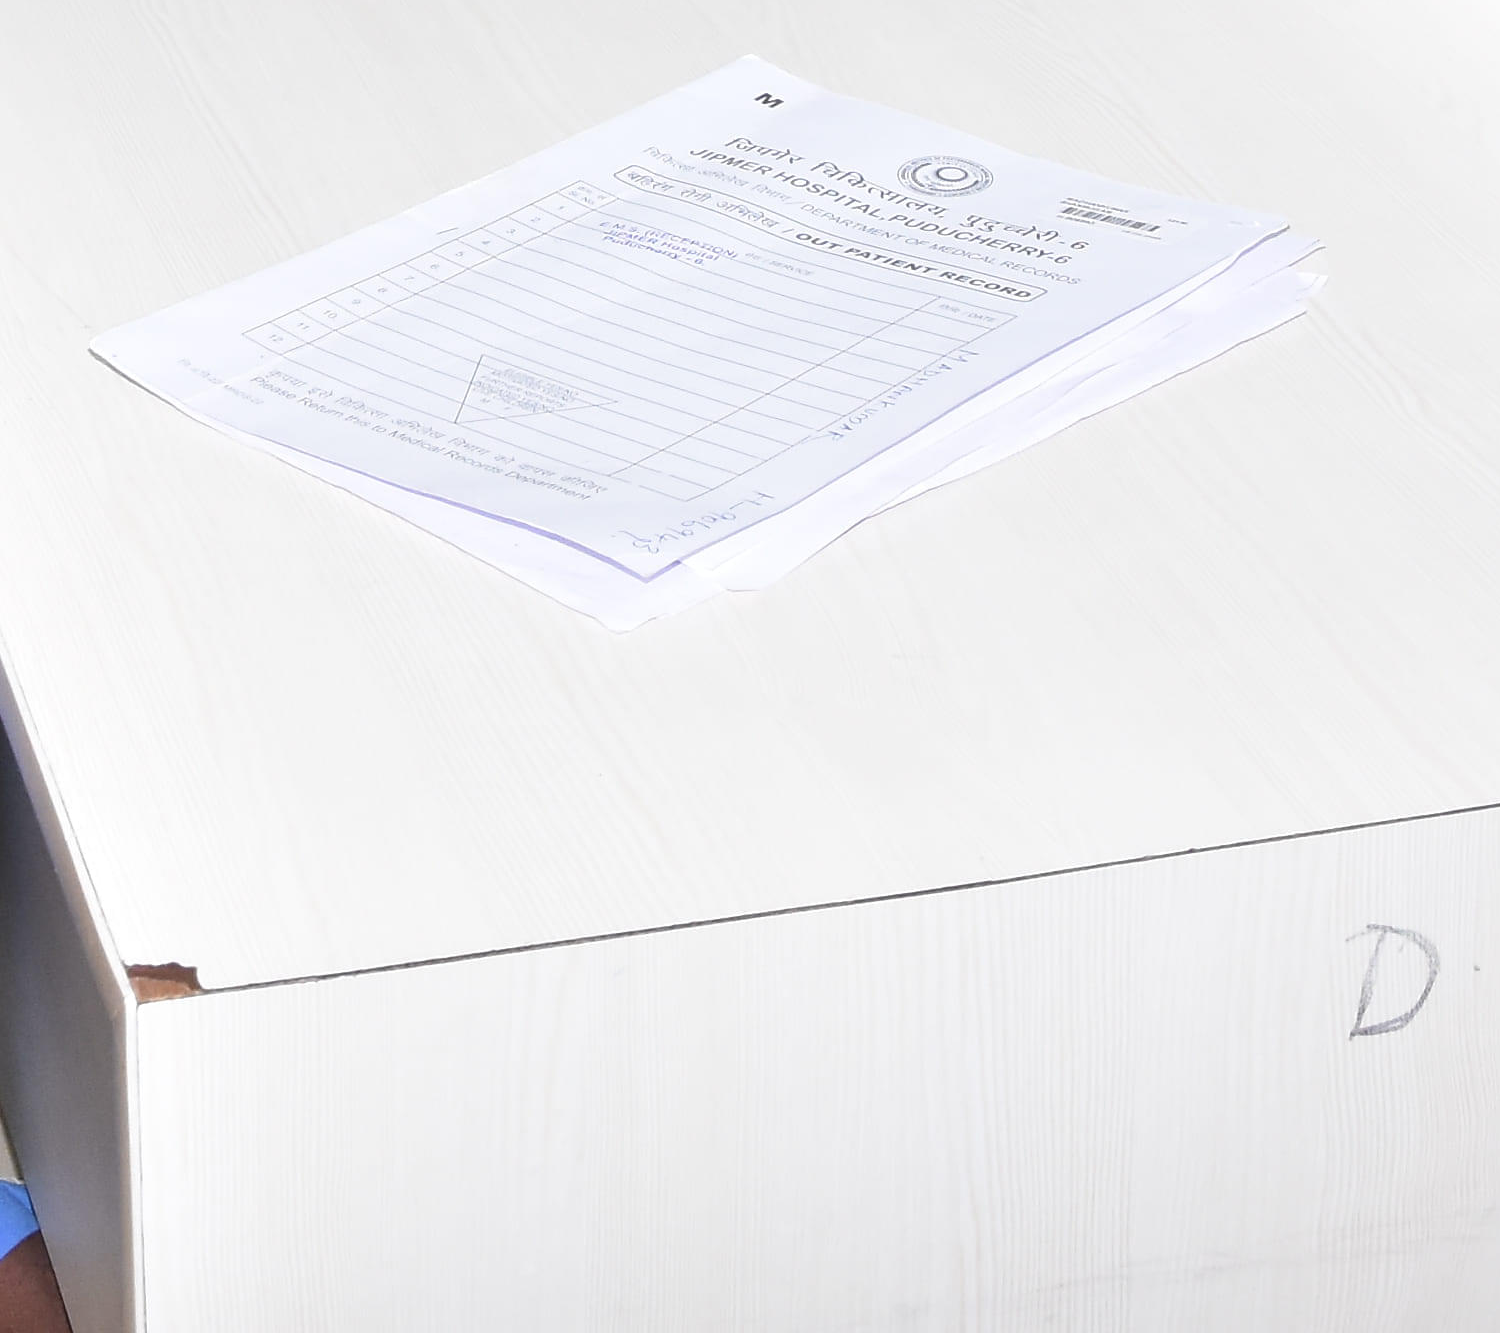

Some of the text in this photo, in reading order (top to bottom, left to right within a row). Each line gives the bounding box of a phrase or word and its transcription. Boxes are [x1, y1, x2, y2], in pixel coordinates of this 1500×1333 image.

[754, 93, 784, 108] M
[690, 149, 773, 175] JIPMER
[796, 233, 843, 249] OUT
[844, 248, 938, 273] PATIENT
[939, 271, 1031, 297] RECORD
[999, 260, 1081, 284] RECORDS
[249, 376, 297, 399] Please
[297, 397, 344, 418] Return
[344, 415, 378, 427] this
[371, 425, 387, 433] to
[388, 430, 446, 453] Medical
[442, 450, 504, 474] Records
[504, 471, 591, 500] Department
